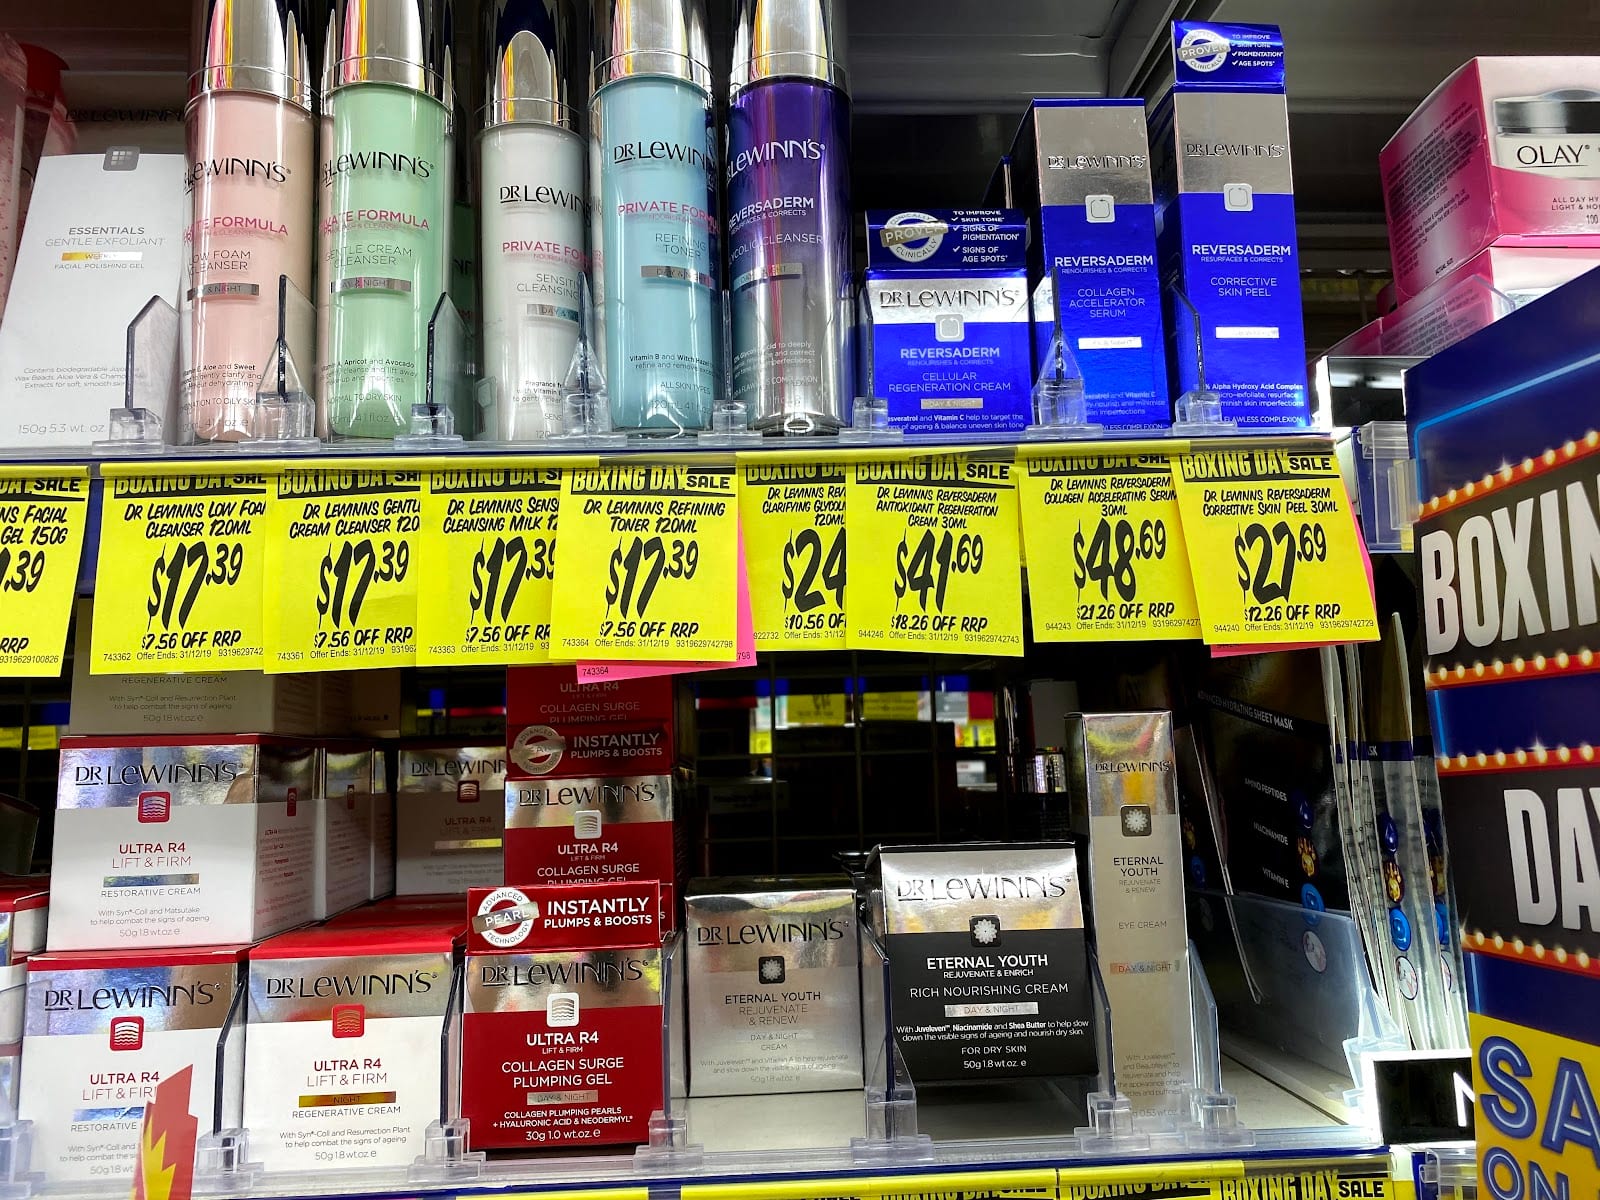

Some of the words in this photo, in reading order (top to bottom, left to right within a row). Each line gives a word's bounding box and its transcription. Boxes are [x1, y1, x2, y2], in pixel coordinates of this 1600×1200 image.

[69, 227, 145, 235] ESSENTIALS
[45, 237, 91, 246] GENTLE
[96, 237, 166, 246] EXFOLIANT
[655, 233, 707, 250] REFINING
[664, 245, 700, 258] TONER
[1192, 245, 1291, 255] REVERSADERM
[1055, 255, 1154, 267] REVERSADERM
[1210, 277, 1277, 286] CORRECTIVE
[1077, 288, 1135, 297] COLLAGEN
[1218, 288, 1242, 296] SKIN
[1245, 288, 1271, 296] PEEL
[1069, 298, 1145, 307] ACCELERATOR
[1089, 309, 1126, 318] SERUM
[900, 348, 1000, 358] REVERSADERM
[923, 372, 977, 381] CELLULAR
[889, 383, 971, 392] REGENERATION
[974, 383, 1011, 391] CREAM
[18, 425, 46, 434] 150g
[1183, 453, 1249, 480] BOXING
[1251, 450, 1288, 477] DAY
[1290, 458, 1332, 471] SALE
[572, 468, 647, 492] BOXING
[651, 466, 688, 490] DAY
[686, 476, 730, 489] SALE
[1110, 476, 1171, 490] REVERSADERM
[936, 489, 997, 502] REVERSADERM
[1044, 491, 1083, 504] COLLAGEN
[1088, 490, 1146, 503] ACCELERATING
[1267, 487, 1331, 500] REVERSADERM
[23, 505, 67, 522] FACIAL
[147, 502, 203, 520] LEWINNS
[208, 502, 237, 517] LOW
[606, 500, 664, 516] LEWINNS
[668, 501, 725, 516] REFINING
[876, 501, 933, 514] ANTIOXIDANT
[937, 503, 998, 517] REGENERATION
[1203, 503, 1254, 516] CORRECTIVE
[1258, 502, 1281, 514] SKIN
[1286, 501, 1307, 514] PEEL
[1311, 501, 1338, 513] 30ML
[290, 522, 330, 538] CREAM
[335, 518, 390, 536] CLEANSER
[443, 516, 504, 533] CLEANSING
[509, 515, 543, 531] MILK
[610, 517, 649, 532] TONER
[655, 516, 697, 533] 120ML
[908, 514, 937, 527] CREAM
[941, 516, 967, 529] 30ML
[1, 528, 23, 543] GEL
[30, 527, 68, 545] 150G
[145, 522, 204, 539] CLEANSER
[209, 520, 251, 536] 120ML
[1073, 518, 1166, 602] $48.69
[1234, 521, 1327, 605] $27.69
[894, 528, 983, 613] $41.69
[316, 539, 410, 629] $17.39
[605, 536, 699, 620] $17.39
[147, 541, 243, 632] $17.39
[1244, 605, 1282, 622] $12.26
[1286, 604, 1310, 620] OFF
[1315, 603, 1341, 620] RRP
[600, 622, 636, 637] $7.56
[640, 622, 666, 637] OFF
[670, 622, 698, 638] RRP
[891, 614, 928, 629] $18.26
[932, 615, 956, 631] OFF
[961, 616, 987, 633] RRP
[142, 633, 179, 650] $7.56
[182, 632, 207, 648] OFF
[212, 630, 242, 647] RRP
[859, 630, 883, 638] 944246
[928, 633, 958, 641] 31/12/19
[562, 639, 589, 647] 743364
[103, 653, 131, 662] 743362
[179, 649, 211, 659] 31/12/19
[574, 733, 660, 748] INSTANTLY
[571, 750, 610, 759] PLUMPS
[622, 747, 662, 758] BOOSTS
[119, 844, 162, 854] ULTRA
[168, 842, 185, 853] R4
[112, 857, 140, 868] LIFT
[144, 857, 154, 867] &
[157, 856, 192, 867] FIRM
[1113, 856, 1163, 866] ETERNAL
[1504, 787, 1600, 932] DA
[537, 866, 598, 877] COLLAGEN
[602, 864, 639, 874] SURGE
[1120, 868, 1158, 877] YOUTH
[101, 889, 165, 898] RESTORATIVE
[167, 888, 201, 896] CREAM
[547, 897, 649, 915] INSTANTLY
[486, 909, 529, 927] PEARL
[544, 916, 590, 928] PLUMPS
[605, 914, 652, 926] BOOSTS
[1119, 921, 1135, 929] EYE
[1138, 920, 1167, 929] CREAM
[927, 956, 994, 970] ETERNAL
[998, 954, 1048, 967] YOUTH
[944, 970, 994, 979] REJUVENATE
[1004, 969, 1033, 977] ENRICH
[910, 987, 939, 998] RICH
[944, 984, 1021, 997] NOURISHING
[1025, 983, 1069, 994] CREAM
[725, 994, 778, 1004] ETERNAL
[782, 992, 821, 1002] YOUTH
[739, 1004, 808, 1016] REJUVENATE
[527, 1032, 574, 1046] ULTRA
[580, 1031, 599, 1044] R4
[961, 1047, 980, 1055] FOR
[1005, 1045, 1026, 1053] SKIN
[314, 1060, 359, 1071] ULTRA
[364, 1058, 381, 1069] R4
[502, 1059, 575, 1073] COLLAGEN
[579, 1057, 624, 1070] SURGE
[513, 1077, 582, 1089] PLUMPING
[586, 1074, 612, 1085] GEL
[292, 1108, 364, 1118] REGENERATIVE
[368, 1106, 400, 1115] CREAM
[71, 1122, 136, 1132] RESTORATIVE
[526, 1130, 546, 1141] 30g
